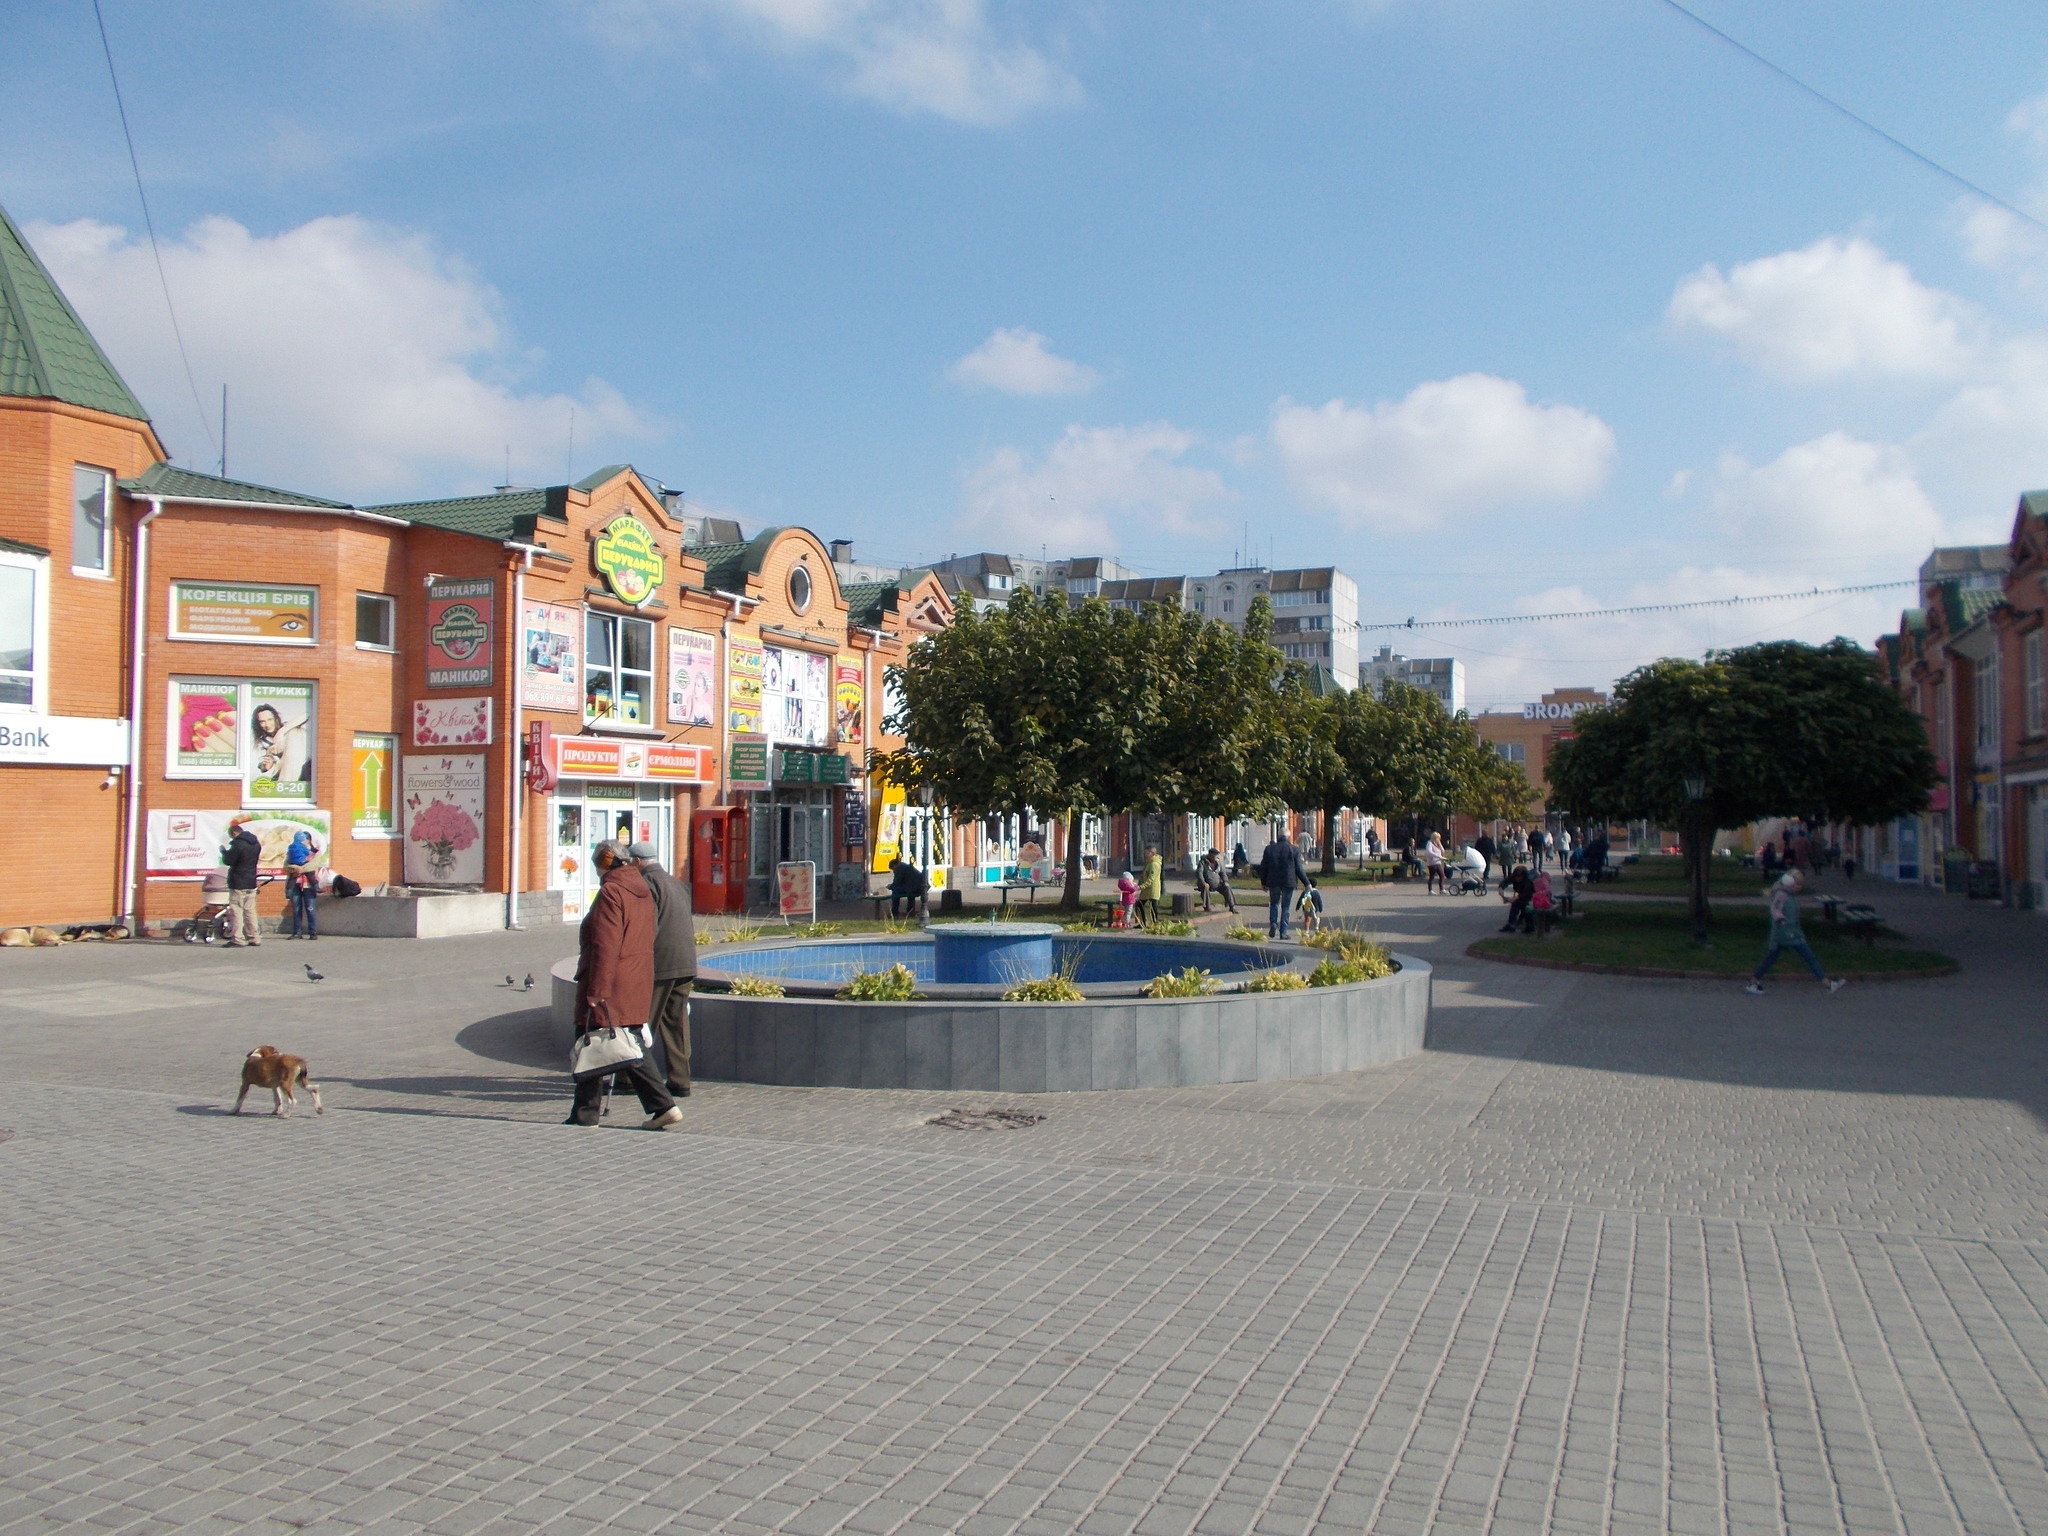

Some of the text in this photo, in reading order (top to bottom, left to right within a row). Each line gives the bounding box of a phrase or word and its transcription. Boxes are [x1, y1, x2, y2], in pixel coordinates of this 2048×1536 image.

[612, 519, 650, 541] МАРАФЕТ
[602, 548, 659, 574] ПЕРУКАРНЯ
[182, 589, 310, 605] КОРЕКЦІЯ БРІВ
[431, 583, 489, 598] ПЕРУКАРНЯ
[443, 606, 477, 619] МАРАФЕТ
[436, 628, 483, 639] ПЕРУКАРНЯ
[673, 632, 712, 651] ПЕРУКАРНЯ
[430, 670, 488, 684] МАНІКЮР
[180, 685, 235, 695] МАНІКЮР
[254, 686, 309, 696] СТРИЖКИ
[430, 706, 475, 728] Квіти
[0, 726, 50, 748] Bank
[532, 722, 542, 776] КВІТИ
[564, 749, 695, 767] ПРОДУКТИ ЄРМОЛІНО
[276, 782, 305, 793] 8-20
[408, 777, 444, 788] flowers
[454, 776, 480, 787] wood
[588, 785, 633, 797] ПЕРУКАРНЯ
[355, 819, 388, 827] ПОВЕРХ
